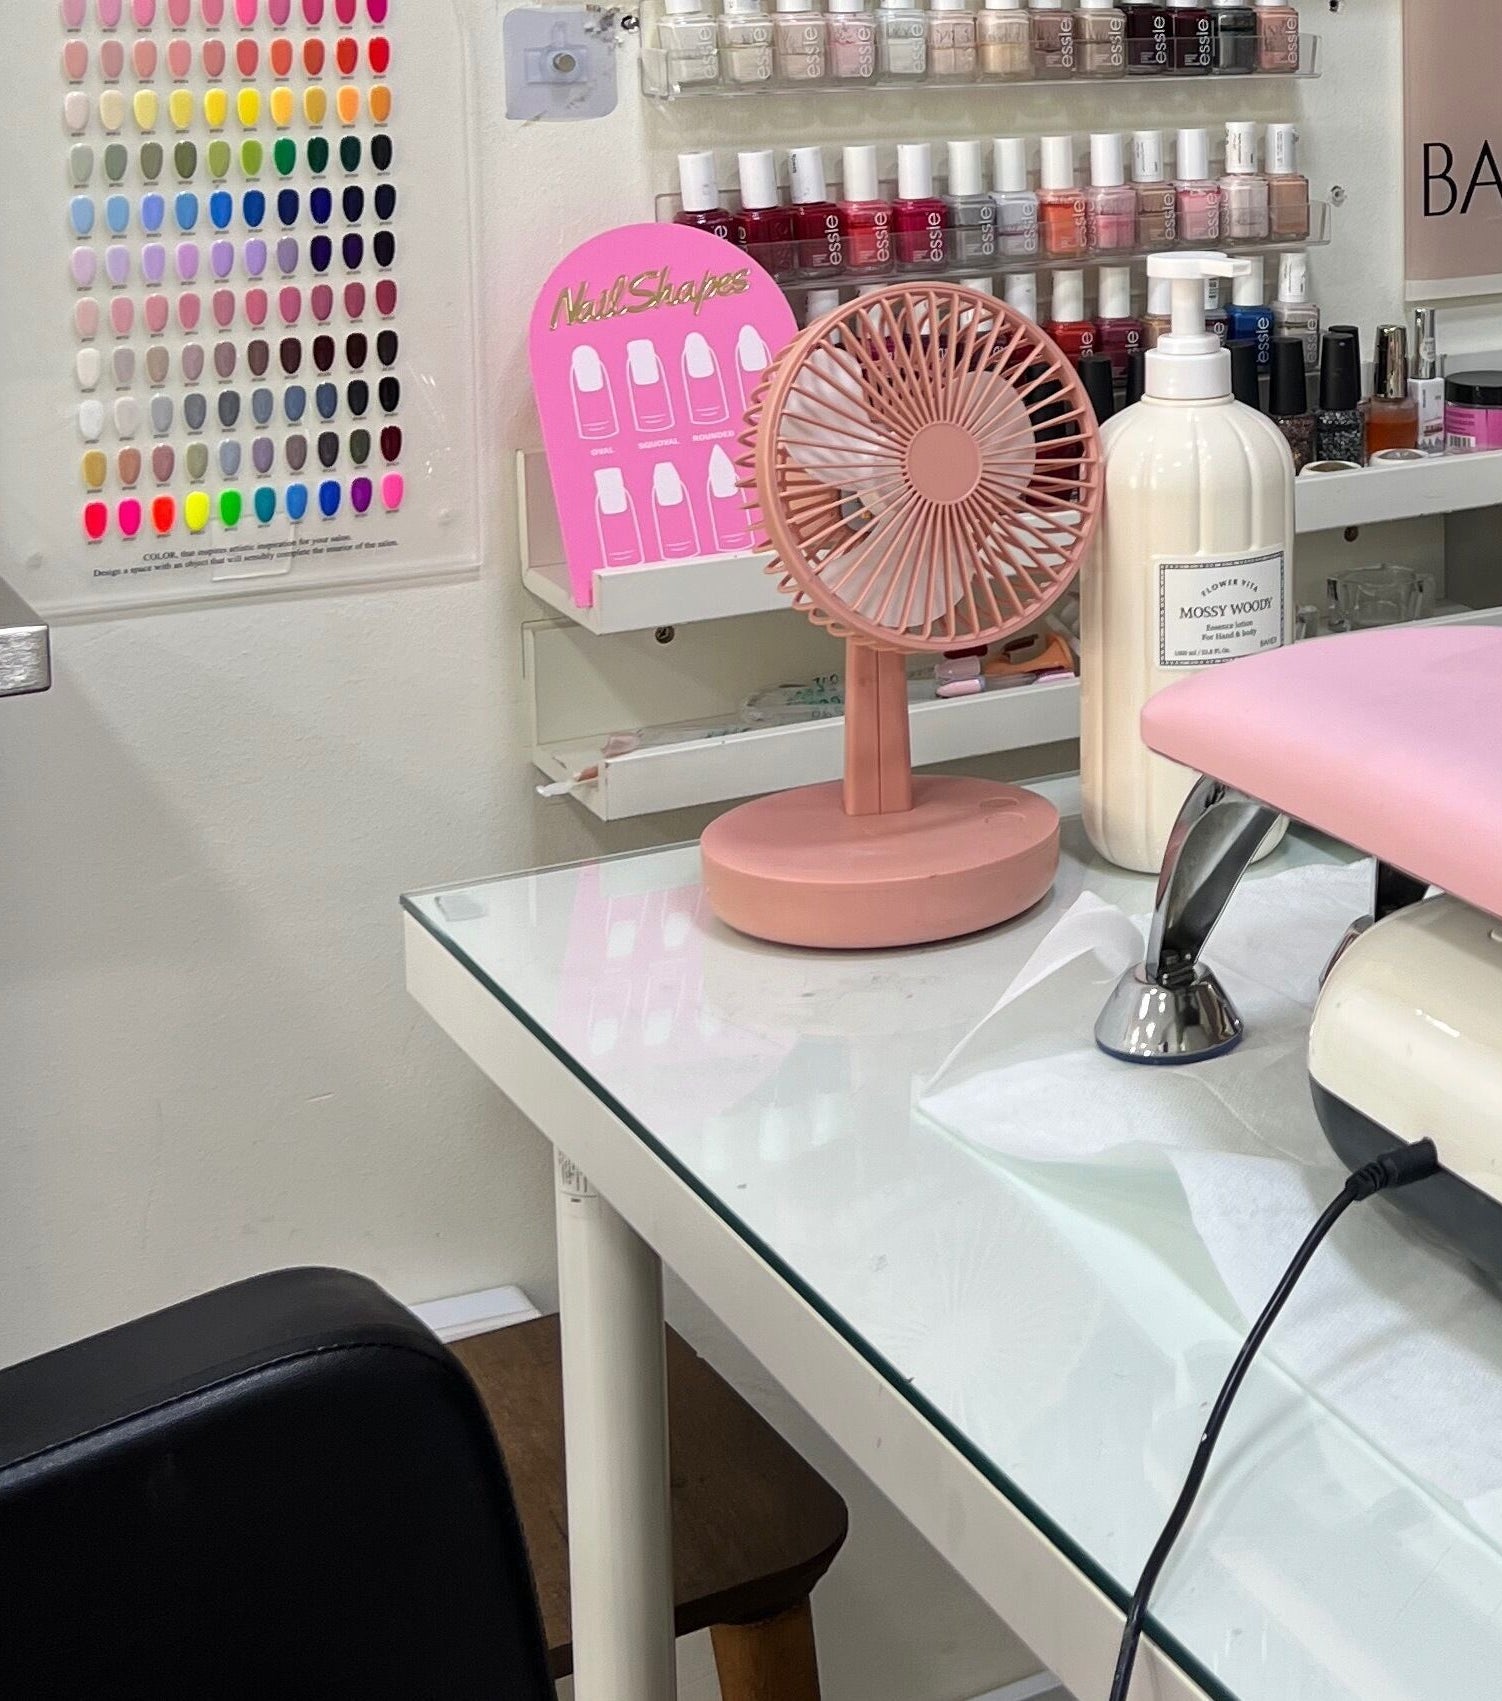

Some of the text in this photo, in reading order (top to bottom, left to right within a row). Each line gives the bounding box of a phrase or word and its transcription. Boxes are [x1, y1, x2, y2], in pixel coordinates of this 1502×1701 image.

[803, 26, 821, 78] essie
[856, 26, 873, 78] essie
[1058, 17, 1074, 68] essie
[1108, 17, 1123, 66] essie
[1152, 15, 1167, 64] essie
[1196, 18, 1210, 66] essie
[825, 214, 842, 265] essie
[872, 212, 890, 262] essie
[926, 212, 943, 262] essie
[979, 206, 994, 255] essie
[1162, 193, 1176, 240] essie
[549, 265, 751, 332] Nail Shapes
[1256, 317, 1270, 363] essie
[93, 568, 121, 577] Design
[130, 565, 151, 574] space
[154, 562, 172, 570] with
[185, 559, 209, 568] object
[143, 551, 178, 562] COLOR,
[1179, 596, 1273, 619] MOSSY WOODY
[1200, 578, 1238, 597] FLOWER
[1201, 633, 1214, 641] For
[1215, 631, 1234, 640] Hand
